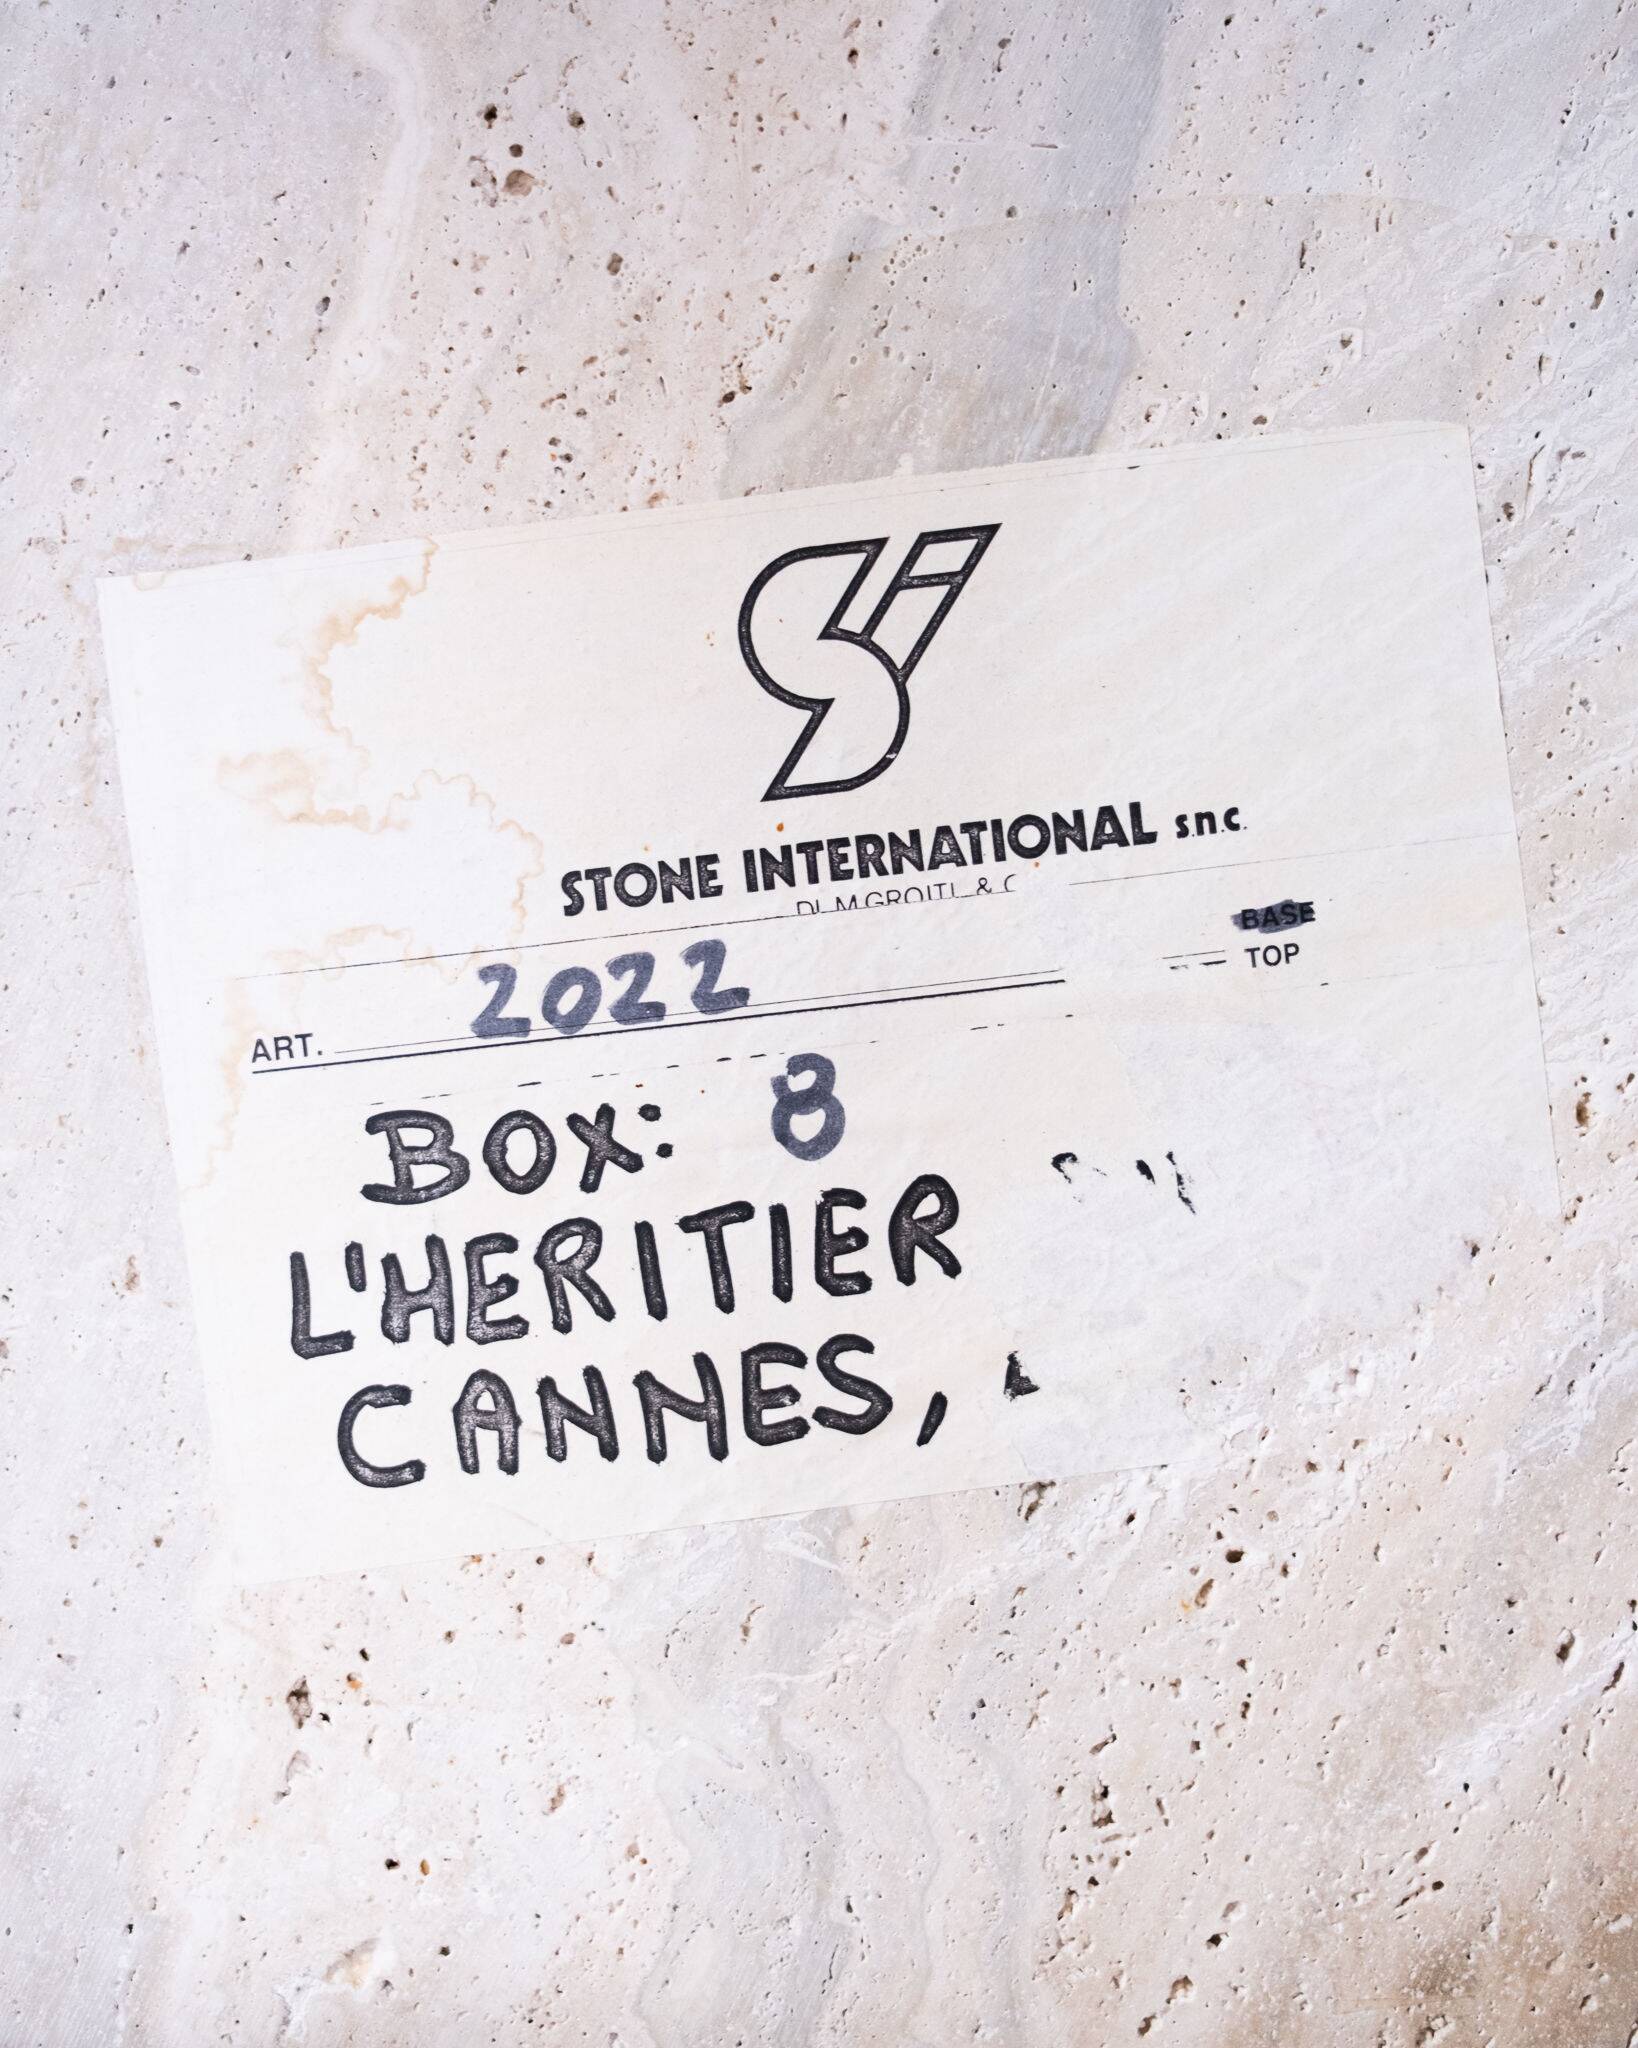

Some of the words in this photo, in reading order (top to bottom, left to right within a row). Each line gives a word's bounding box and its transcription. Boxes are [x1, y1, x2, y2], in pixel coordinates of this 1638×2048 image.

[561, 853, 724, 917] STONE
[743, 801, 1158, 893] INTERNATIONAL
[1175, 807, 1248, 840] s.n.c.
[1241, 901, 1316, 930] BASE
[251, 1032, 323, 1063] ART.
[470, 938, 750, 1039] 2022
[1244, 942, 1300, 968] TOP
[360, 1102, 674, 1206] BOX:
[770, 1052, 846, 1161] 8
[290, 1173, 962, 1360] L'HERITIER
[337, 1333, 949, 1488] CANNES,
